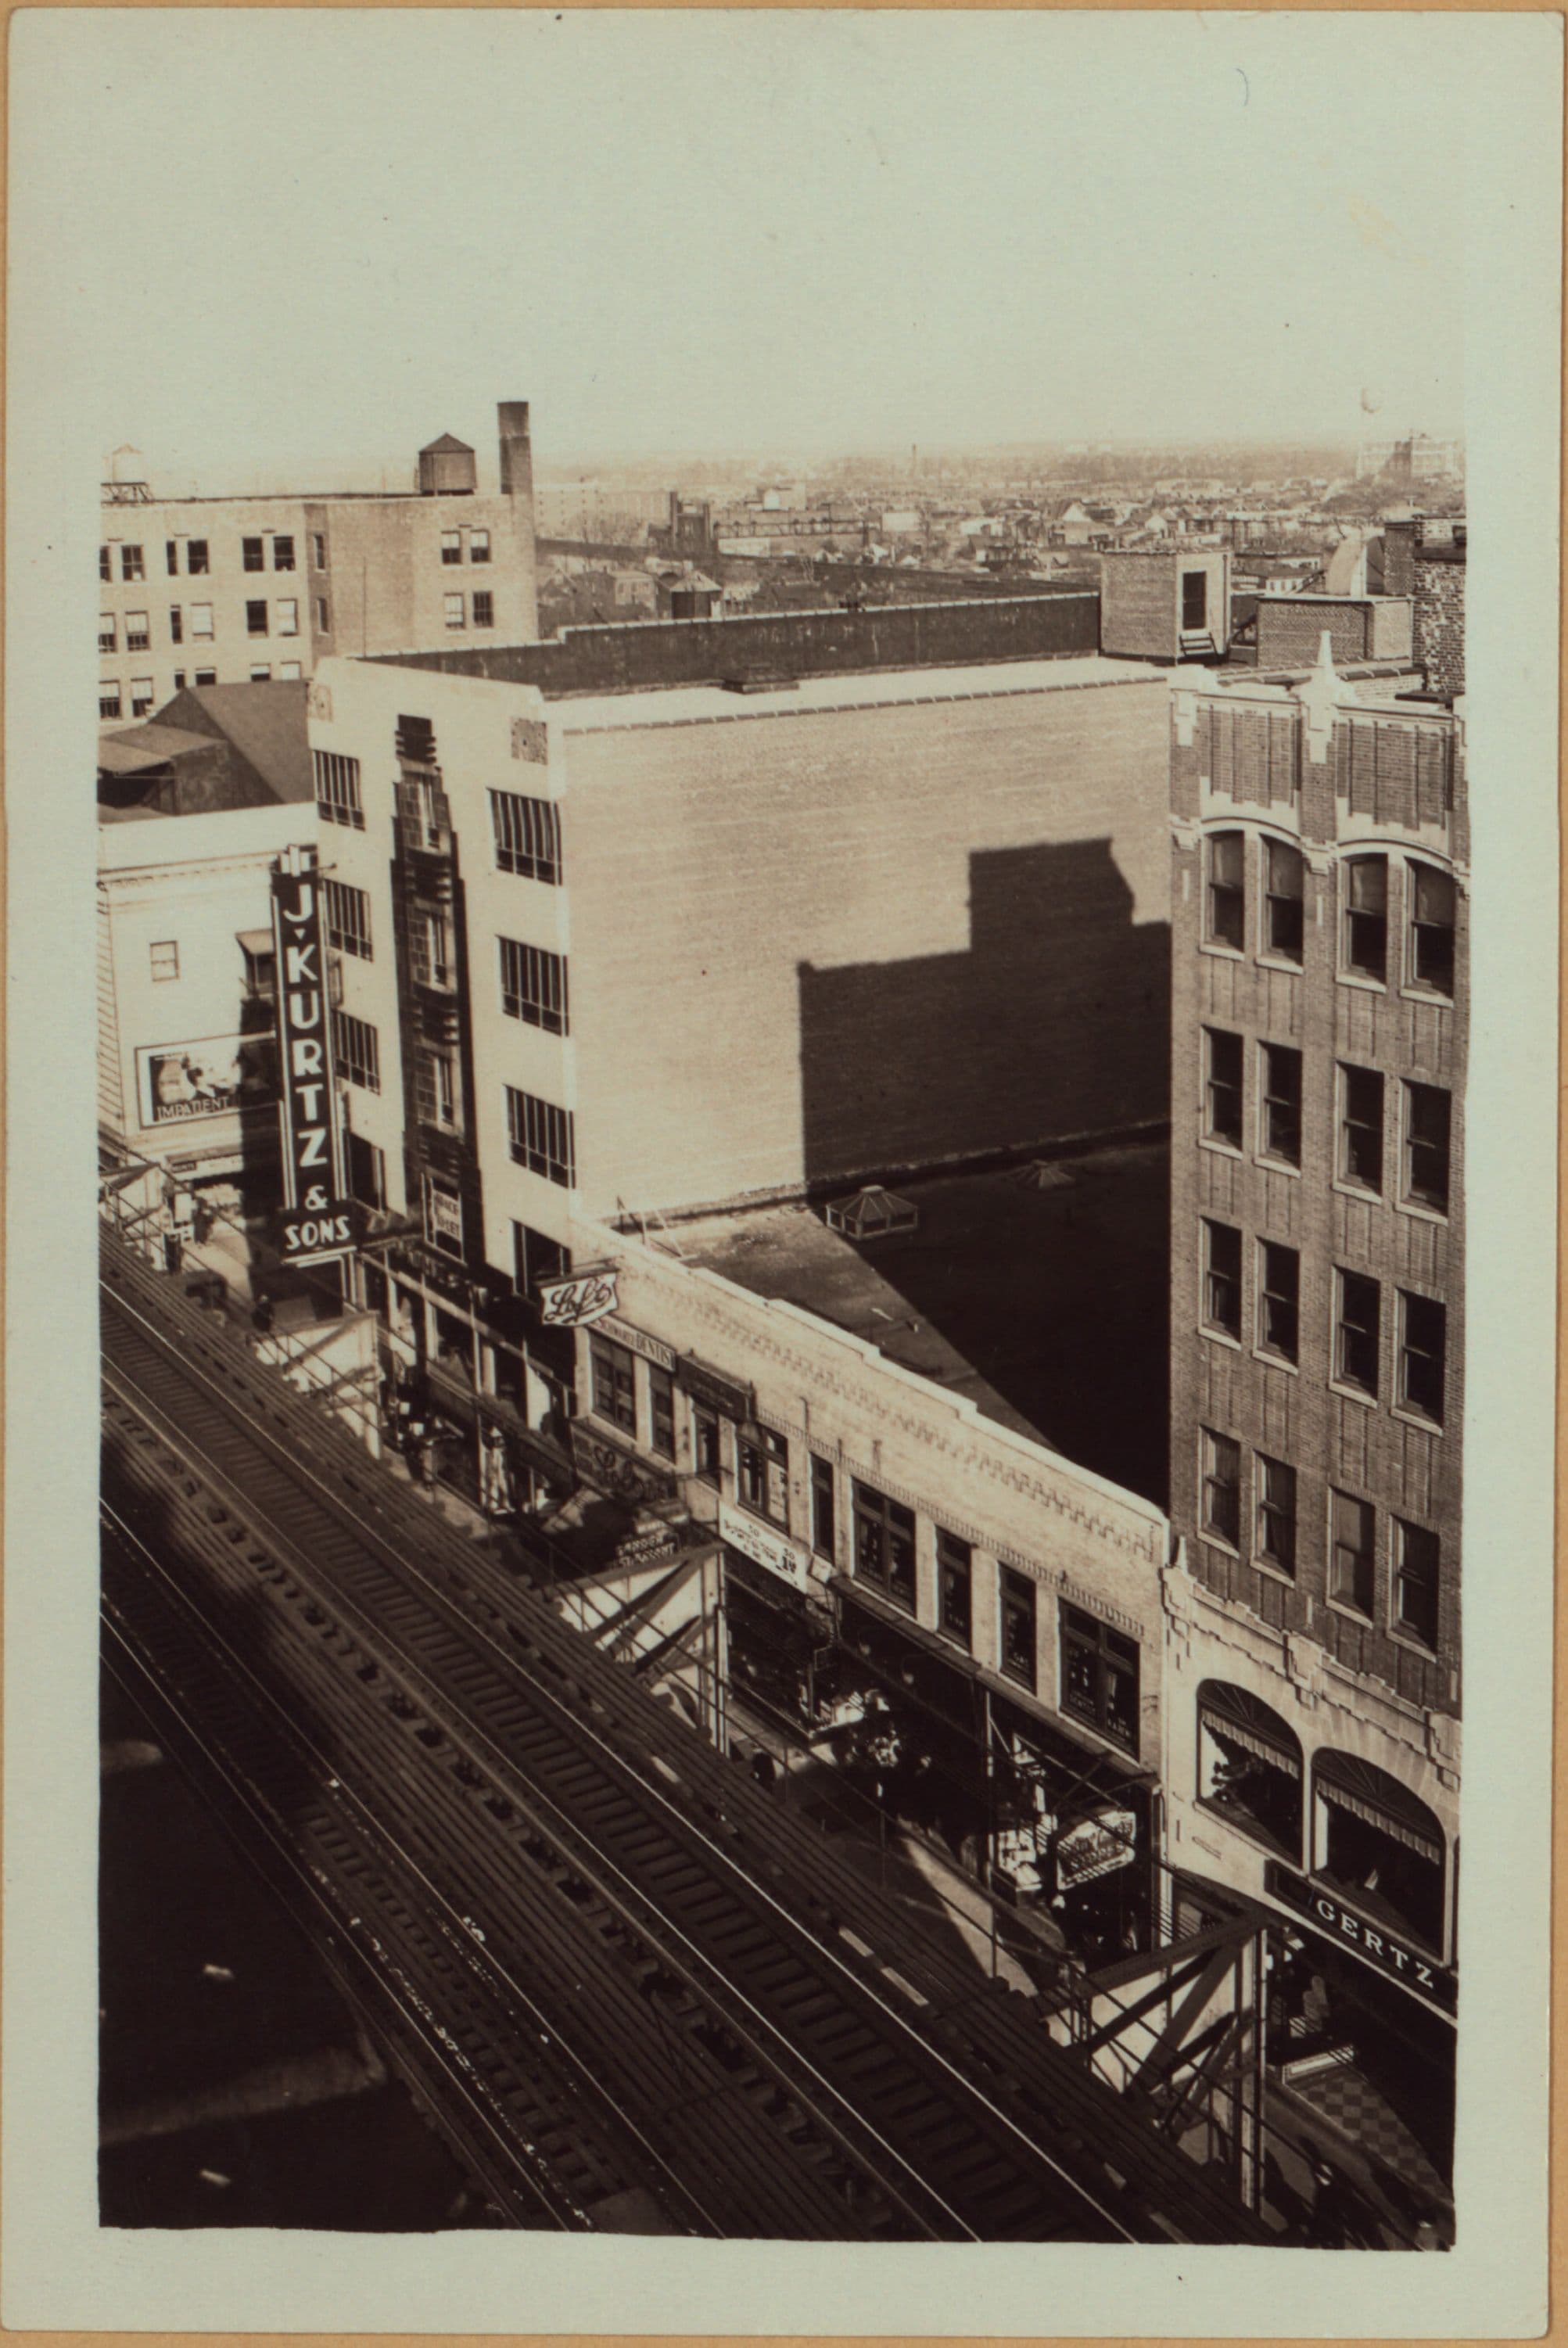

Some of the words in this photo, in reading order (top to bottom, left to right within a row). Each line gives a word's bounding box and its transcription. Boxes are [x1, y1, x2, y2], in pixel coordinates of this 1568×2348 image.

[286, 944, 328, 1167] KURTZ
[305, 1185, 328, 1211] &
[285, 1215, 350, 1250] SONS
[1317, 1899, 1433, 1989] GERTZ
